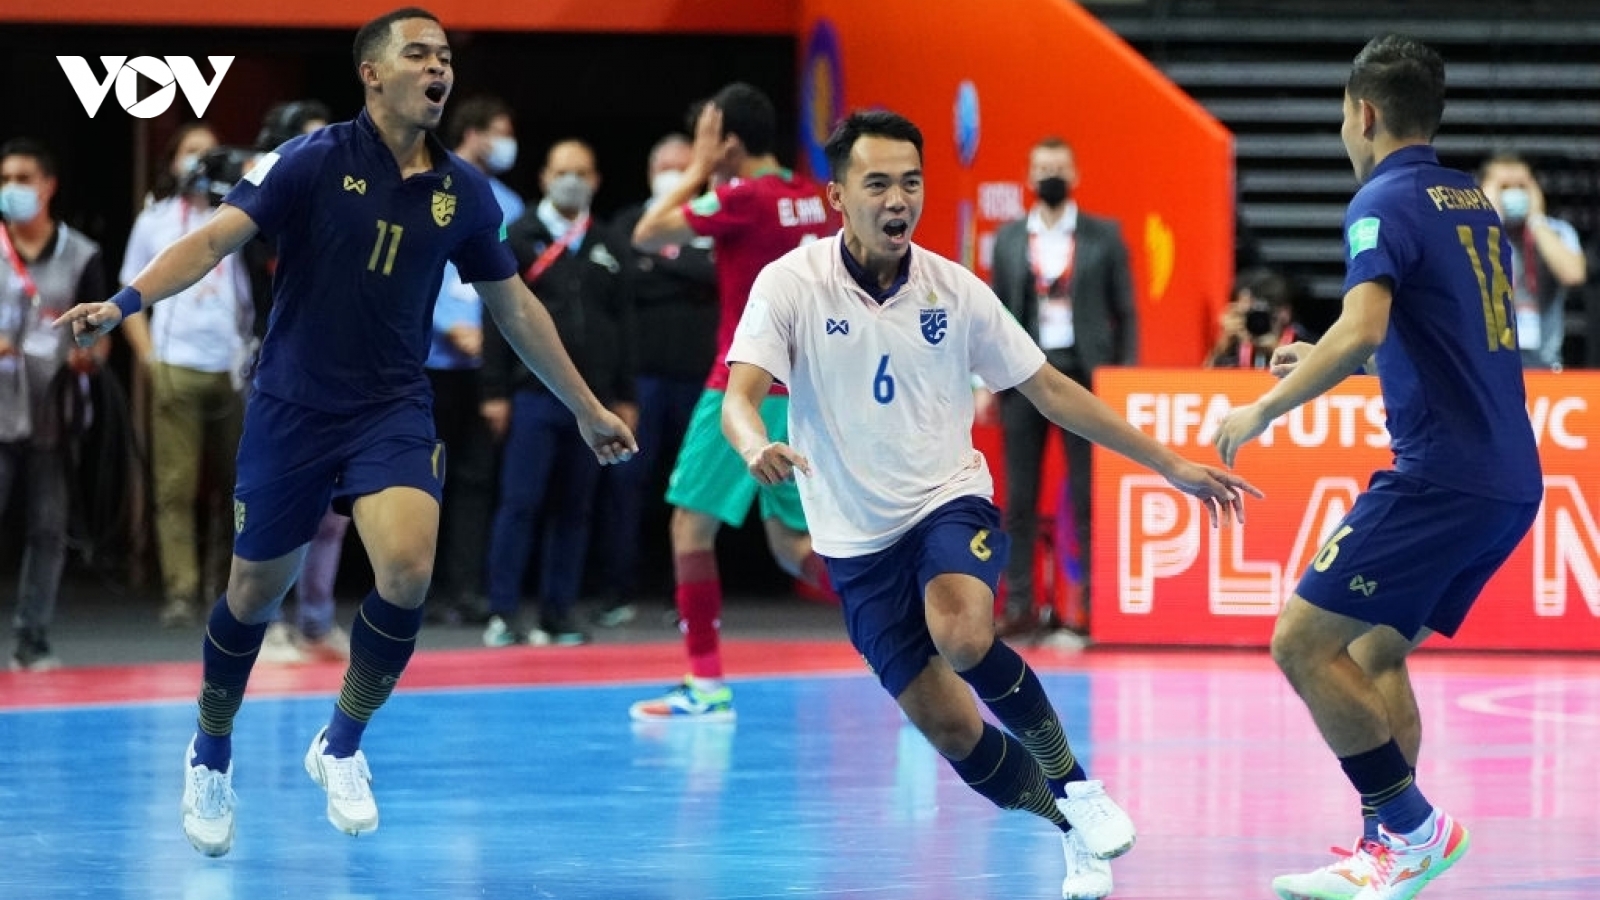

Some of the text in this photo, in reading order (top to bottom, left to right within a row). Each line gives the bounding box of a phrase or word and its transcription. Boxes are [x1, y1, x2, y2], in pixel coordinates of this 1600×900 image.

[367, 219, 404, 276] 11
[1456, 225, 1516, 352] 16
[873, 354, 895, 404] 6
[1126, 393, 1236, 446] FIFA
[970, 529, 992, 562] 6
[1313, 525, 1354, 573] 6
